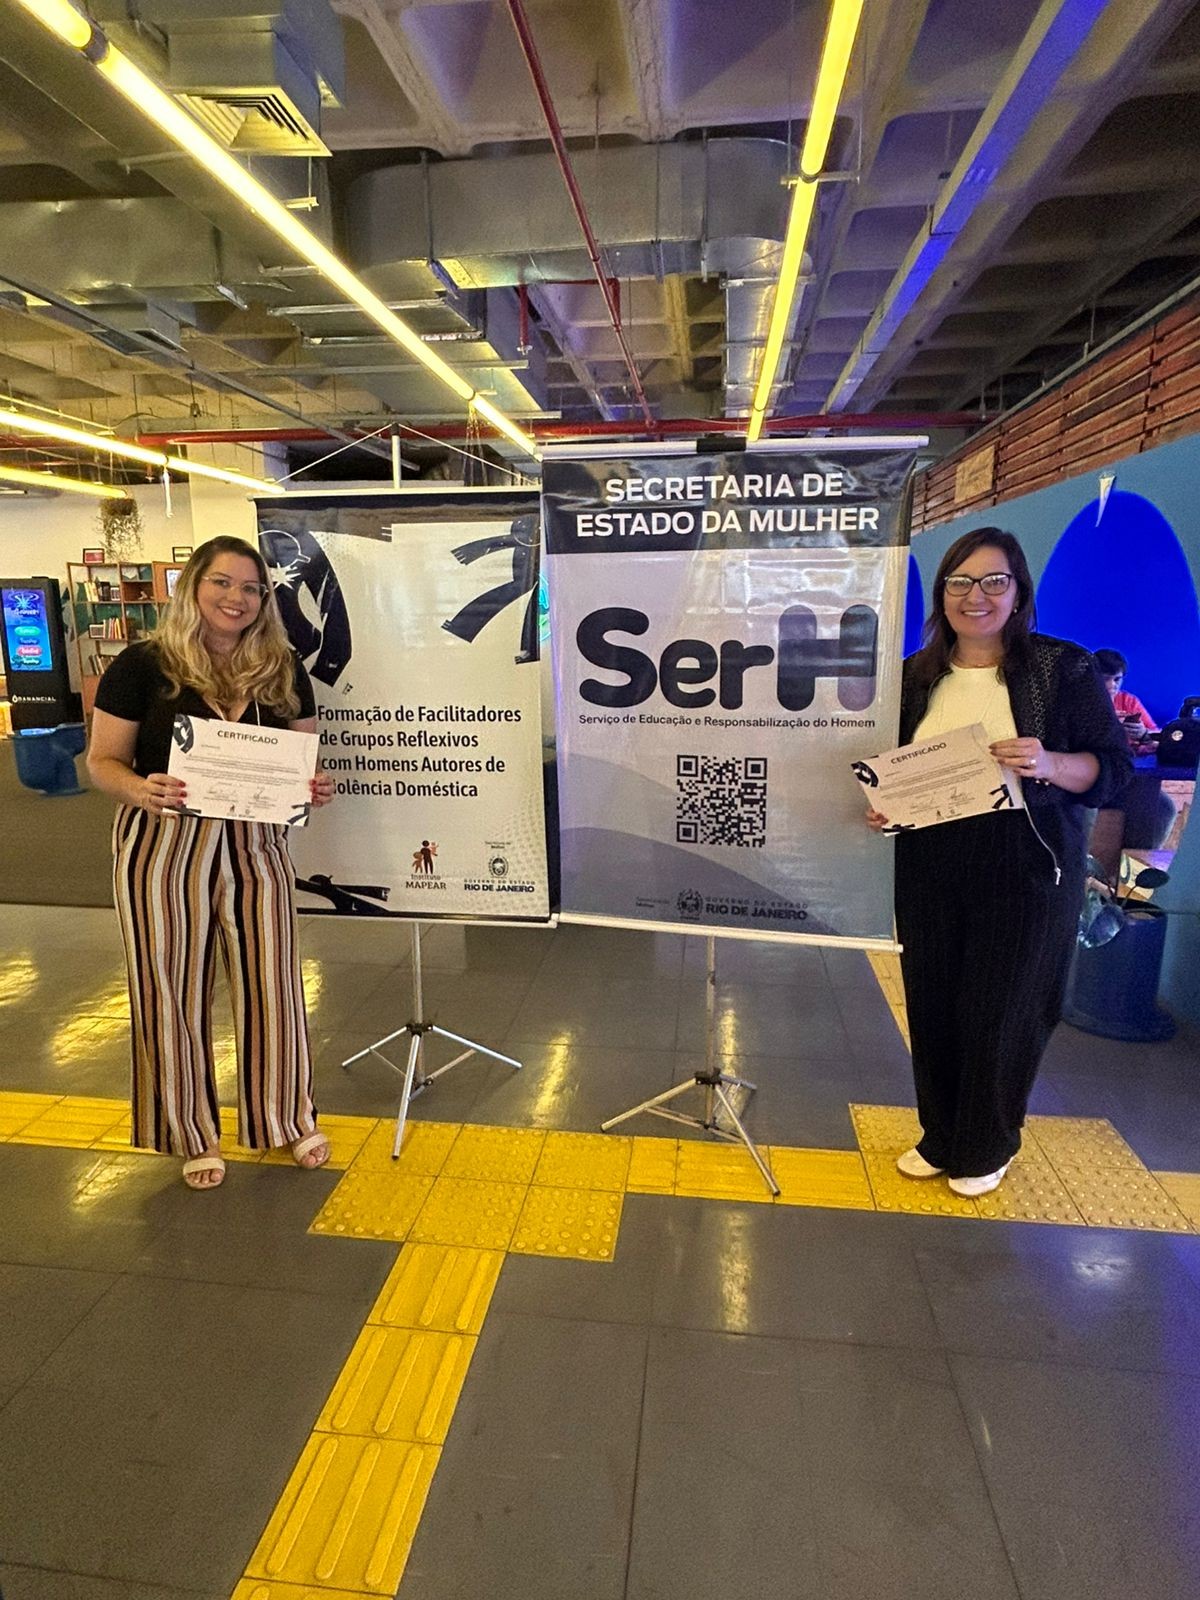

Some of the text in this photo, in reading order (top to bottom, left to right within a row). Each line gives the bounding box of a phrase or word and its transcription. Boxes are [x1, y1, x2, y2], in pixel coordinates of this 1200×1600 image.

[605, 473, 843, 502] SECRETARIA DE
[576, 508, 880, 537] ESTADO DA MULHER
[317, 705, 521, 726] Formação de Facilitadores
[579, 714, 620, 725] Serviço
[622, 714, 636, 723] de
[639, 714, 692, 726] Educação
[704, 716, 810, 729] Responsabilização
[813, 718, 828, 727] do
[831, 718, 876, 727] Homem
[217, 730, 279, 745] CERTIFICADO
[319, 730, 479, 750] de Grupos Reflexivos
[891, 742, 947, 765] CERTIFICADO
[321, 755, 505, 773] com Homens Autores de
[333, 779, 478, 797] iolência Doméstica
[405, 881, 447, 890] MAPEAR
[496, 885, 535, 893] JANEIRO
[705, 903, 808, 920] RIO DE JANEIRO
